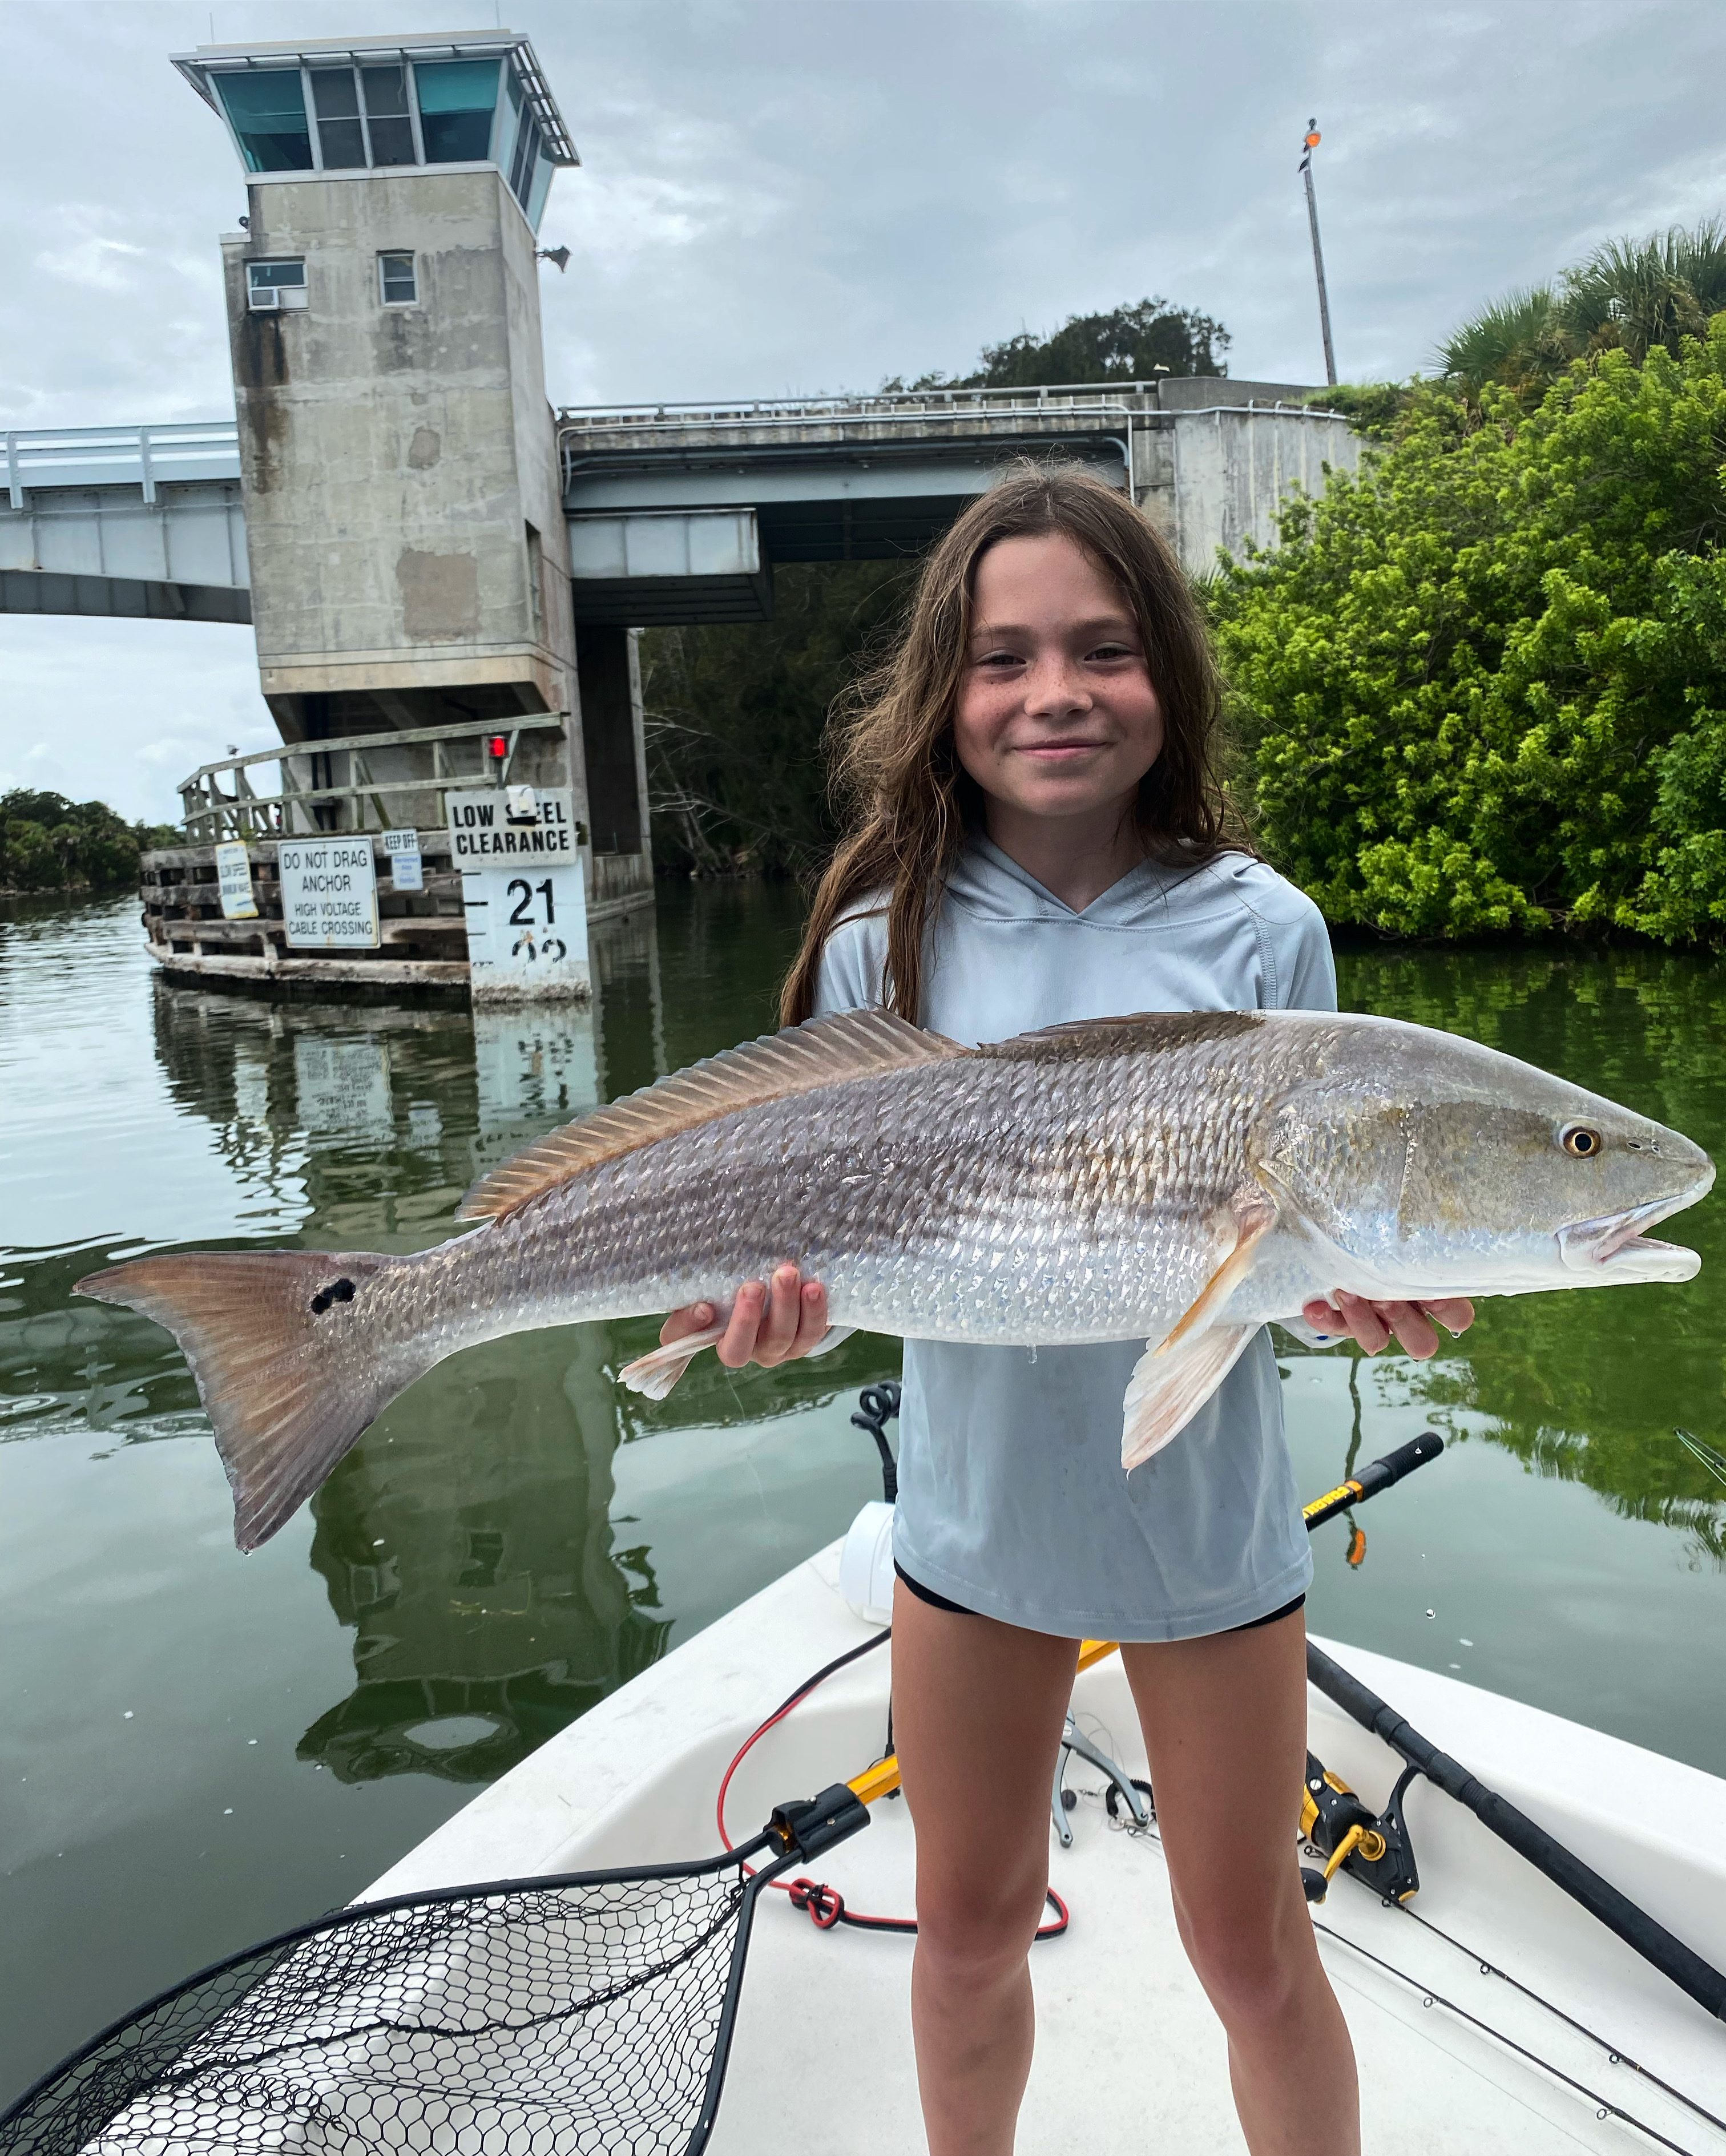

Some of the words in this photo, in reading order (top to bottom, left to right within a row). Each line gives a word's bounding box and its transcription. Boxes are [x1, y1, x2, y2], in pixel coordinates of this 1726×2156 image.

[453, 805, 494, 827] LOW
[385, 835, 401, 850] KEEP
[402, 834, 415, 849] OFF
[456, 830, 569, 855] CLEARANCE
[284, 853, 300, 869] DO
[305, 851, 328, 869] NOT
[333, 850, 367, 867] DRAG
[302, 875, 351, 892] ANCHOR
[295, 903, 316, 916] HIGH
[320, 902, 361, 916] VOLTAGE
[507, 879, 555, 925] 21
[289, 920, 317, 935] CABLE
[321, 920, 372, 935] CROSSING
